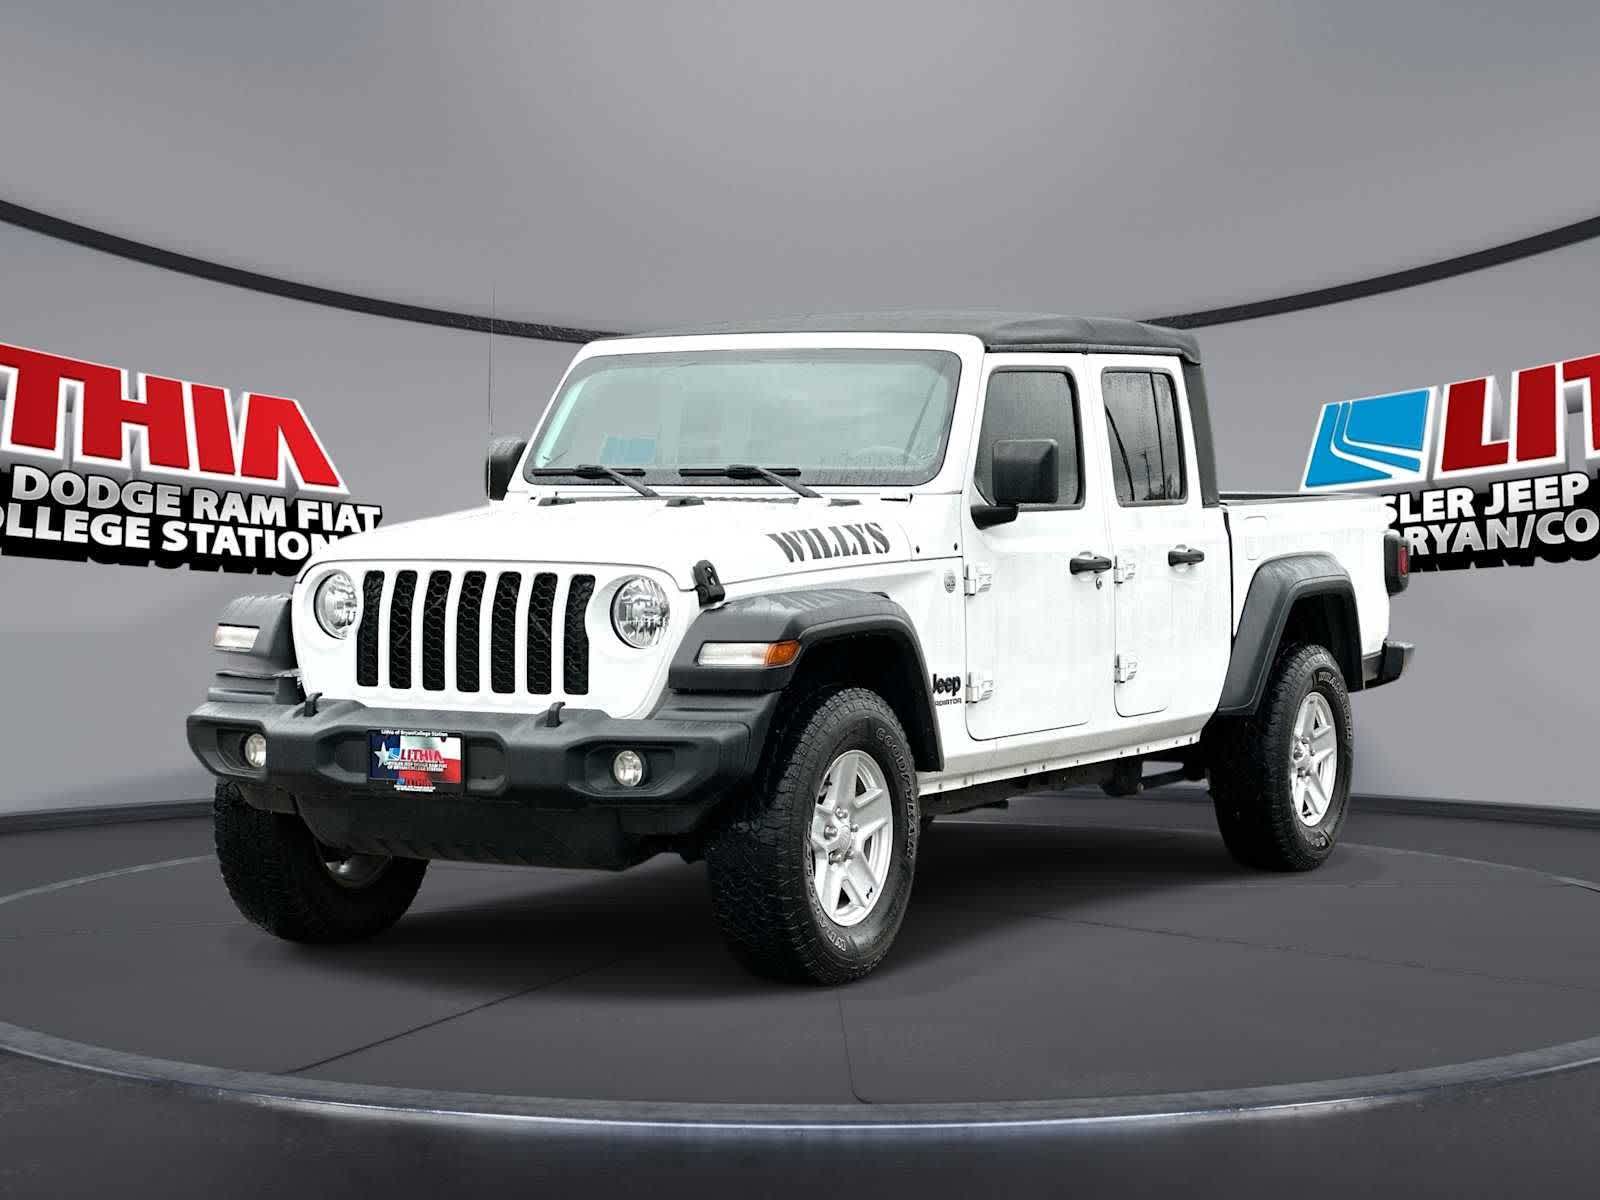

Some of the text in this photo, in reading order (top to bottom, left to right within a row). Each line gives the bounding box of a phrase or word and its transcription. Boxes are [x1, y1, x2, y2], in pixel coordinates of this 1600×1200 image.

[12, 466, 381, 533] DODGE RAM FIAT
[1484, 472, 1590, 516] JEEP
[0, 503, 151, 549] LLEGE
[765, 522, 890, 563] WILLYS
[1402, 508, 1600, 556] RYAN/CO
[932, 673, 961, 696] Jeep
[400, 748, 444, 762] LITHIA
